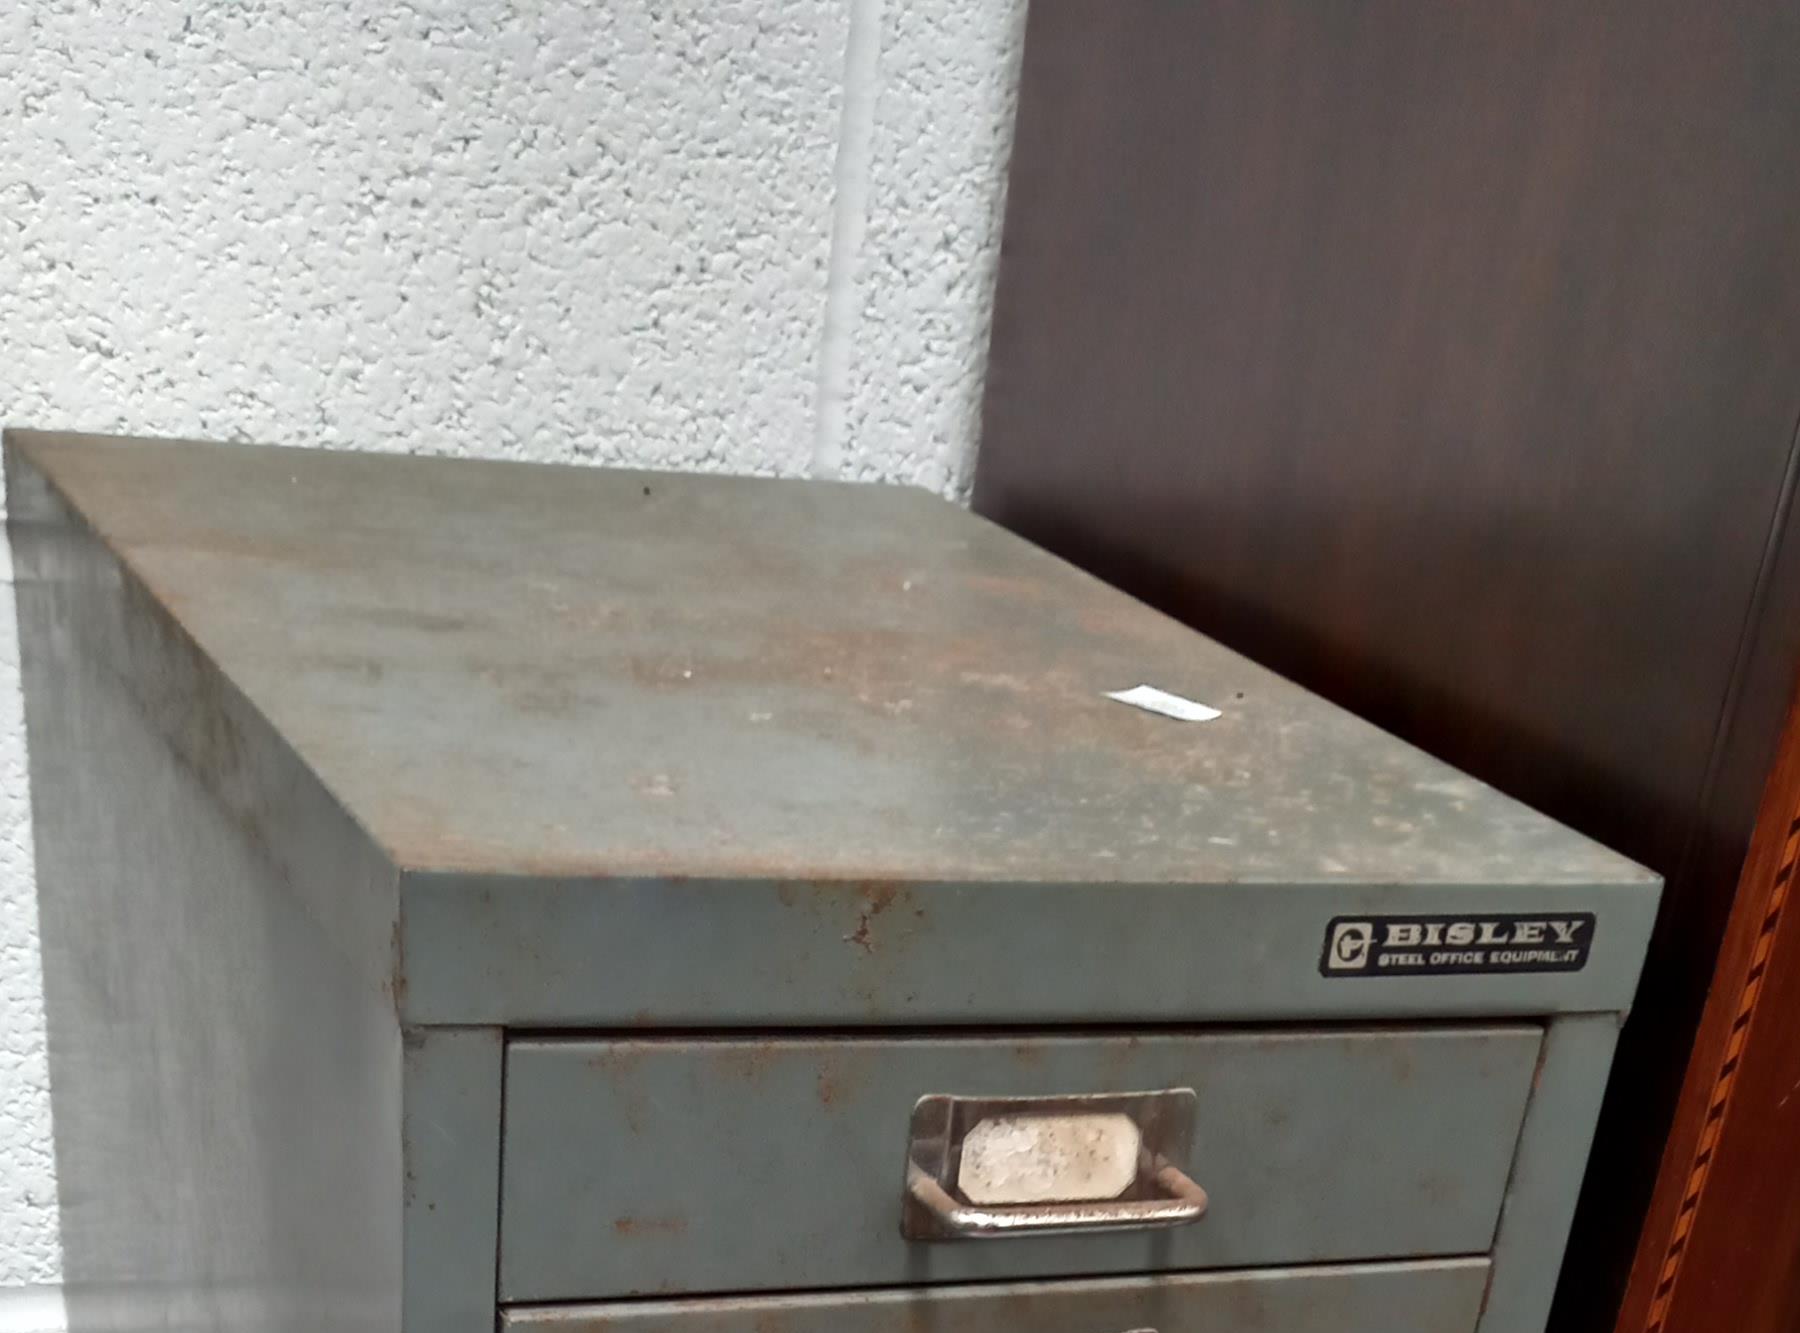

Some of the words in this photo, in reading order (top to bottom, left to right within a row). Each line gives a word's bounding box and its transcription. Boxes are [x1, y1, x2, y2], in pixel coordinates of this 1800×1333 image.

[1383, 921, 1584, 947] BISLEY
[1378, 953, 1425, 967] STEEL
[1429, 951, 1484, 965] OFFICE
